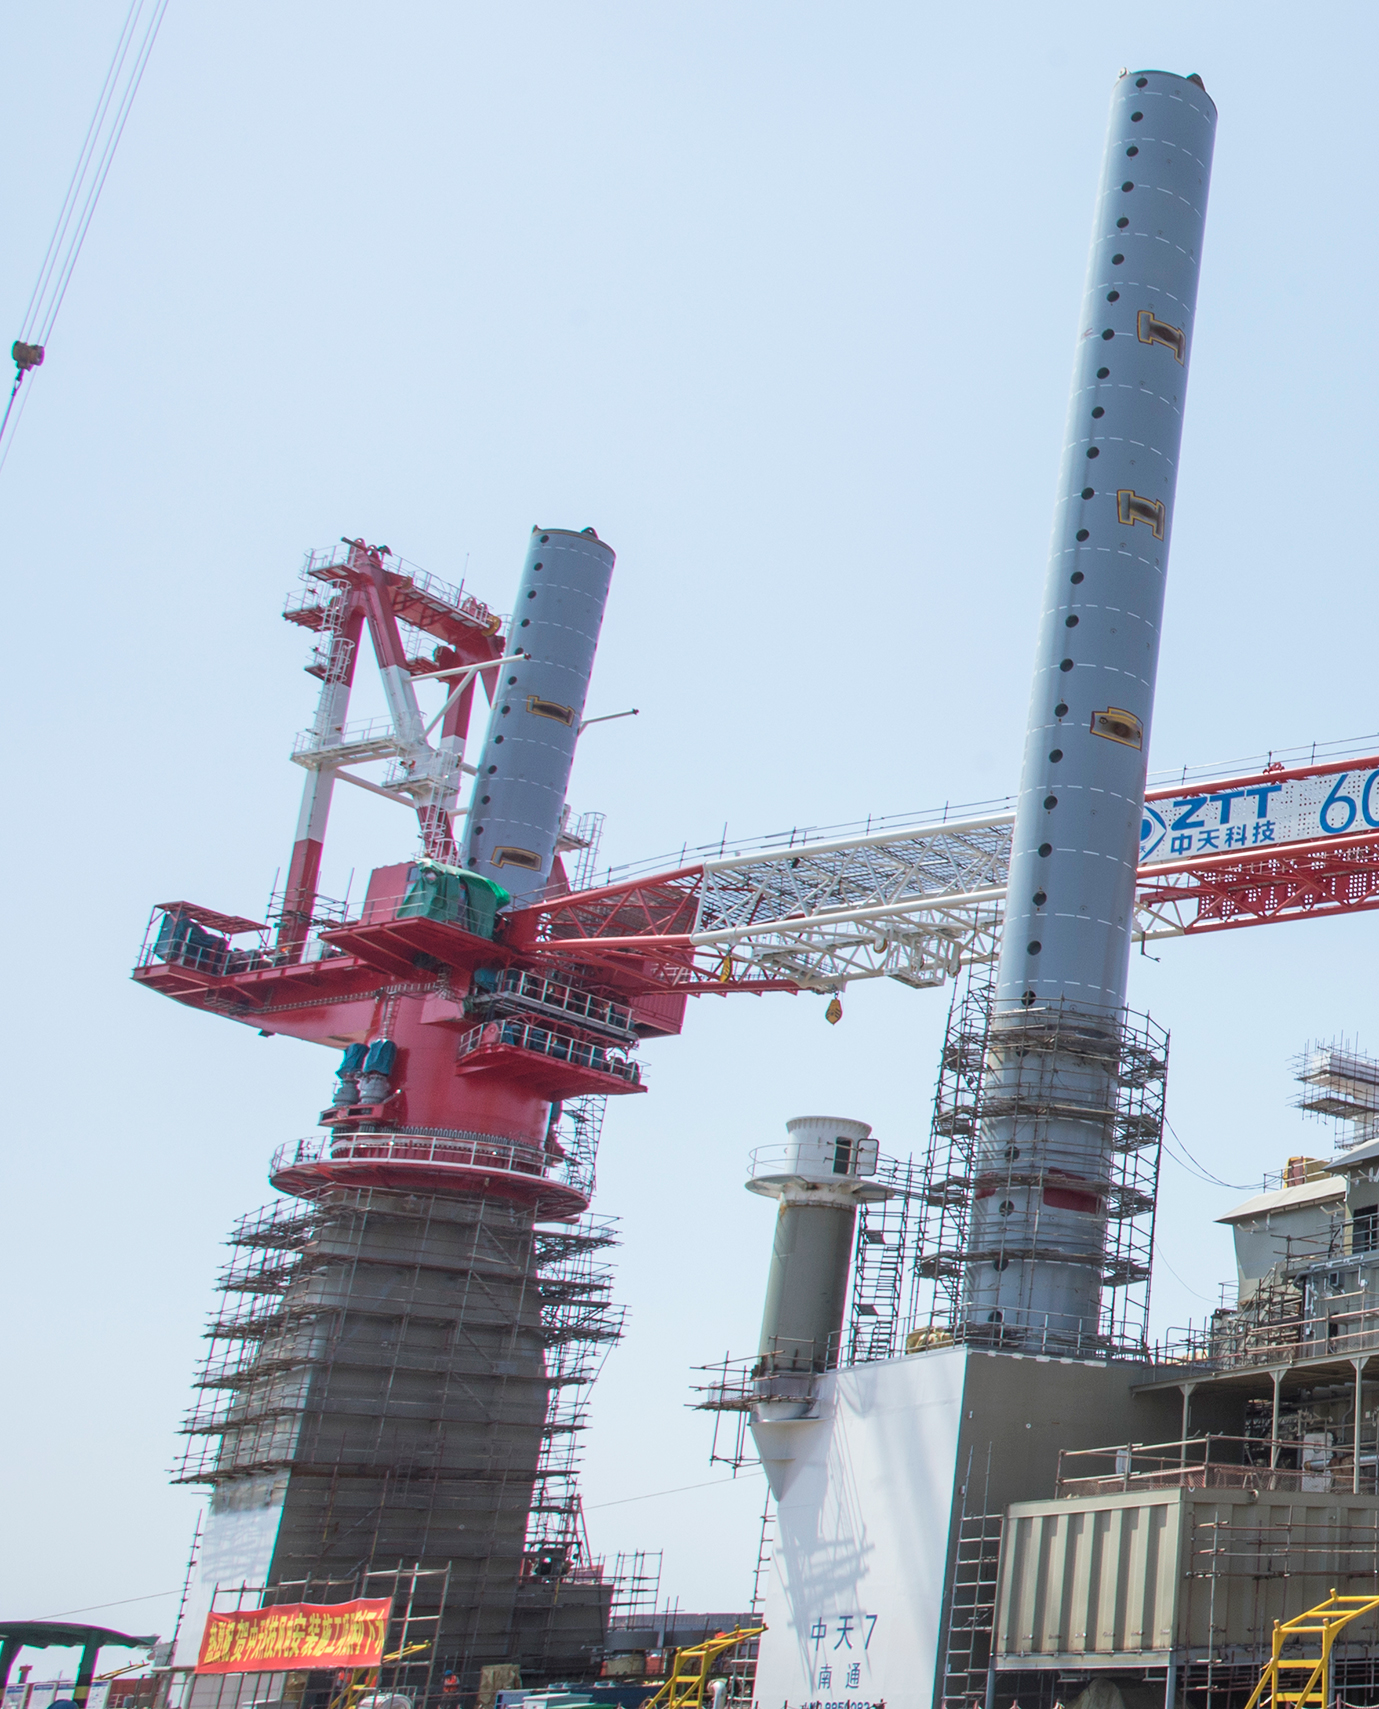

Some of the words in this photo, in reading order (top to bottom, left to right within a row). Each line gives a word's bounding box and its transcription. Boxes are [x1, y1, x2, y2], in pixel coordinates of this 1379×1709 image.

[1170, 785, 1282, 831] ZTT
[1170, 820, 1276, 856] 中天科技
[818, 1662, 861, 1690] 南通
